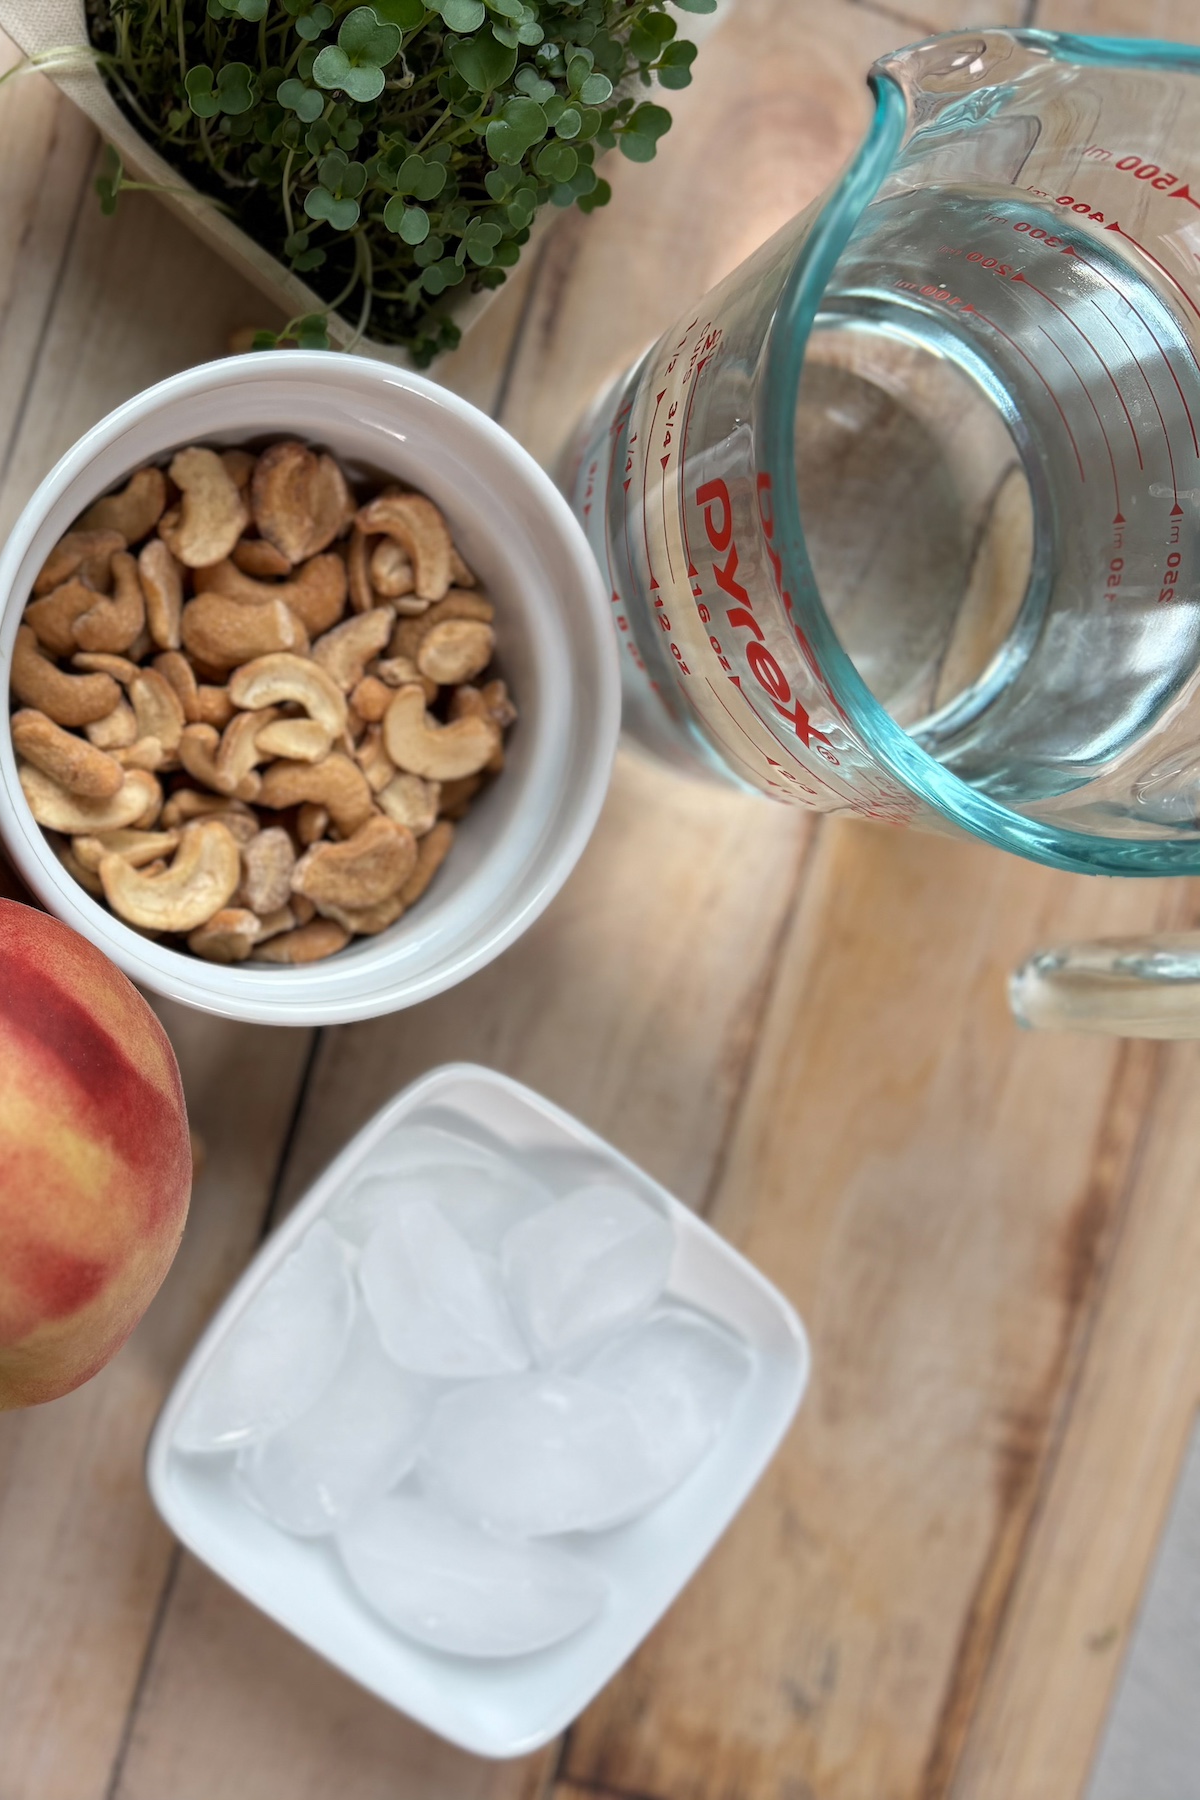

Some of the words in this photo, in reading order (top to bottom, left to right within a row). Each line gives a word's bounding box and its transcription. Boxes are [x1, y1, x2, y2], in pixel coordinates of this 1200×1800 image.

[663, 401, 678, 448] 3/4
[654, 595, 671, 632] 12
[670, 643, 691, 675] oz
[692, 583, 711, 623] 16
[709, 636, 732, 671] oz
[696, 478, 833, 749] pyrex
